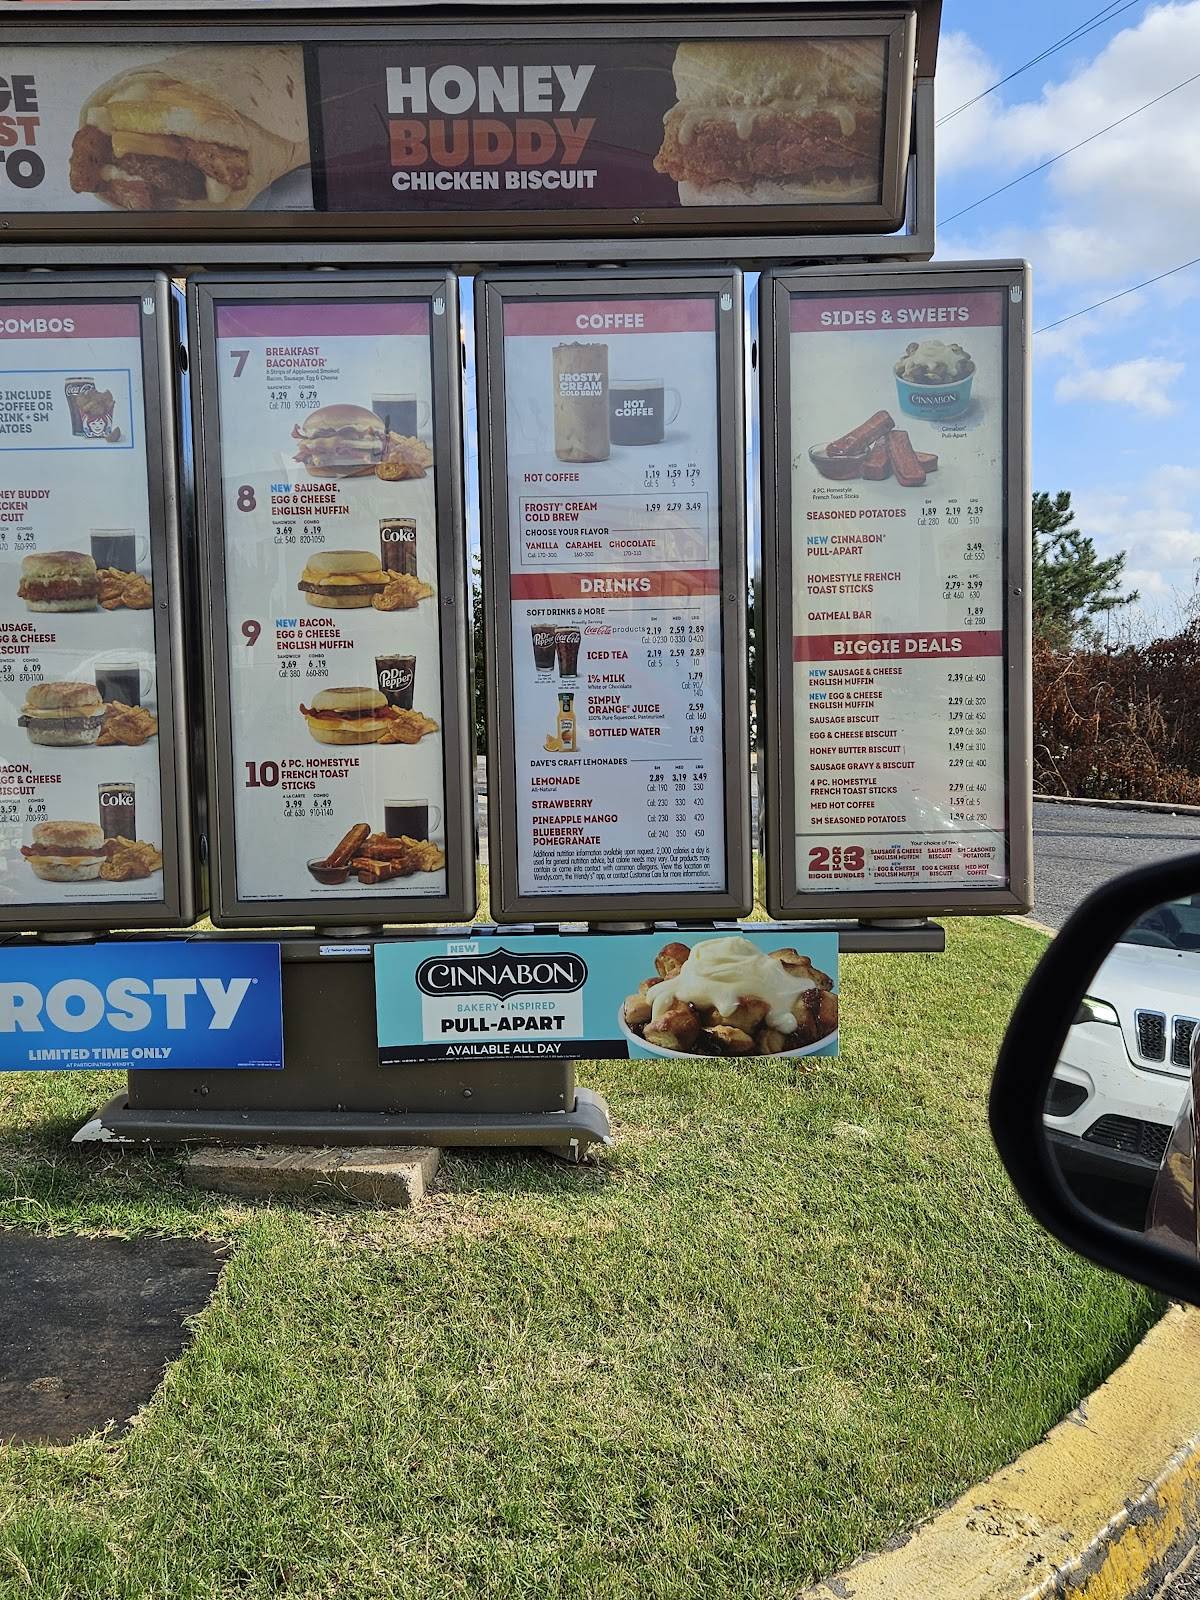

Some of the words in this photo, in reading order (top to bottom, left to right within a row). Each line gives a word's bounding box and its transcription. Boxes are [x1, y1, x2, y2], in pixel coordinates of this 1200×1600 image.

[386, 65, 596, 114] HONEY
[389, 118, 596, 167] BUDDY
[391, 171, 499, 191] CHICKEN
[505, 169, 597, 190] BISCUIT
[575, 313, 644, 328] COFFEE
[821, 310, 876, 325] SIDES
[881, 309, 893, 323] &
[897, 307, 970, 323] SWEETS
[230, 350, 250, 377] 7
[266, 347, 319, 356] BREAKFAST
[559, 373, 601, 382] FROSTY
[559, 382, 602, 390] CREAM
[6, 391, 51, 400] INCLUDE
[624, 400, 645, 408] HOT
[615, 408, 653, 416] COFFEE
[524, 474, 543, 482] HOT
[545, 473, 579, 481] COFFEE
[19, 490, 50, 499] BUDDY
[237, 485, 256, 512] 8
[271, 484, 292, 492] NEW
[271, 496, 290, 504] EGG
[300, 495, 335, 504] CHEESE
[272, 507, 312, 516] ENGLISH
[314, 506, 349, 515] MUFFIN
[565, 502, 597, 511] CREAM
[646, 504, 660, 512] 1.99
[525, 514, 550, 522] COLD
[553, 513, 579, 521] BREW
[807, 511, 856, 520] SEASONED
[859, 509, 906, 518] POTATOES
[381, 528, 415, 542] Coke
[807, 536, 828, 545] NEW
[807, 546, 863, 556] PULL-APART
[807, 574, 862, 583] HOMESTYLE
[864, 572, 901, 581] FRENCH
[581, 578, 650, 592] DRINKS
[808, 586, 837, 594] TOAST
[839, 585, 873, 594] STICKS
[808, 612, 850, 621] OATMEAL
[852, 611, 872, 619] BAR
[241, 620, 261, 646] 9
[276, 619, 297, 628] NEW
[300, 619, 335, 628] BACON,
[277, 630, 295, 639] EGG
[297, 630, 303, 638] &
[305, 630, 340, 638] CHEESE
[670, 626, 684, 634] 2.59
[277, 642, 317, 650] ENGLISH
[319, 640, 353, 649] MUFFIN
[834, 639, 899, 655] BIGGIE
[905, 638, 963, 653] DEALS
[588, 675, 600, 683] 1%
[602, 675, 624, 683] MILK
[948, 674, 963, 682] 2.39
[588, 696, 620, 704] SIMPLY
[632, 704, 660, 713] JUICE
[689, 703, 704, 711] 2.59
[847, 715, 879, 723] BISCUIT
[589, 728, 628, 737] BOTTLED
[630, 728, 660, 736] WATER
[810, 747, 837, 755] HONEY
[583, 758, 627, 766] LEMONADES
[847, 762, 874, 770] GRAVY
[882, 761, 915, 769] BISCUIT
[246, 761, 279, 787] 10
[281, 759, 286, 767] 6
[288, 759, 304, 767] PC.
[306, 758, 359, 767] HOMESTYLE
[282, 770, 318, 779] FRENCH
[319, 770, 349, 778] TOAST
[532, 776, 580, 785] LEMONADE
[650, 774, 663, 782] 2.89
[693, 773, 707, 781] 3.49
[282, 782, 316, 790] STICKS
[100, 792, 134, 807] Coke
[532, 800, 593, 808] STRAWBERRY
[533, 816, 581, 824] PINEAPPLE
[584, 815, 617, 823] MANGO
[533, 828, 584, 836] BLUEBERRY
[533, 836, 600, 845] POMEGRANATE
[808, 847, 829, 871] 2
[450, 944, 476, 953] NEW
[457, 1003, 498, 1012] BAKERY
[507, 1002, 555, 1011] INSPIRED
[441, 1016, 565, 1033] PULL-APART
[28, 1048, 89, 1061] LIMITED
[94, 1048, 128, 1059] TIME
[131, 1047, 172, 1059] ONLY
[446, 1045, 510, 1056] AVAILABLE
[513, 1045, 534, 1054] ALL
[537, 1044, 561, 1053] DAY
